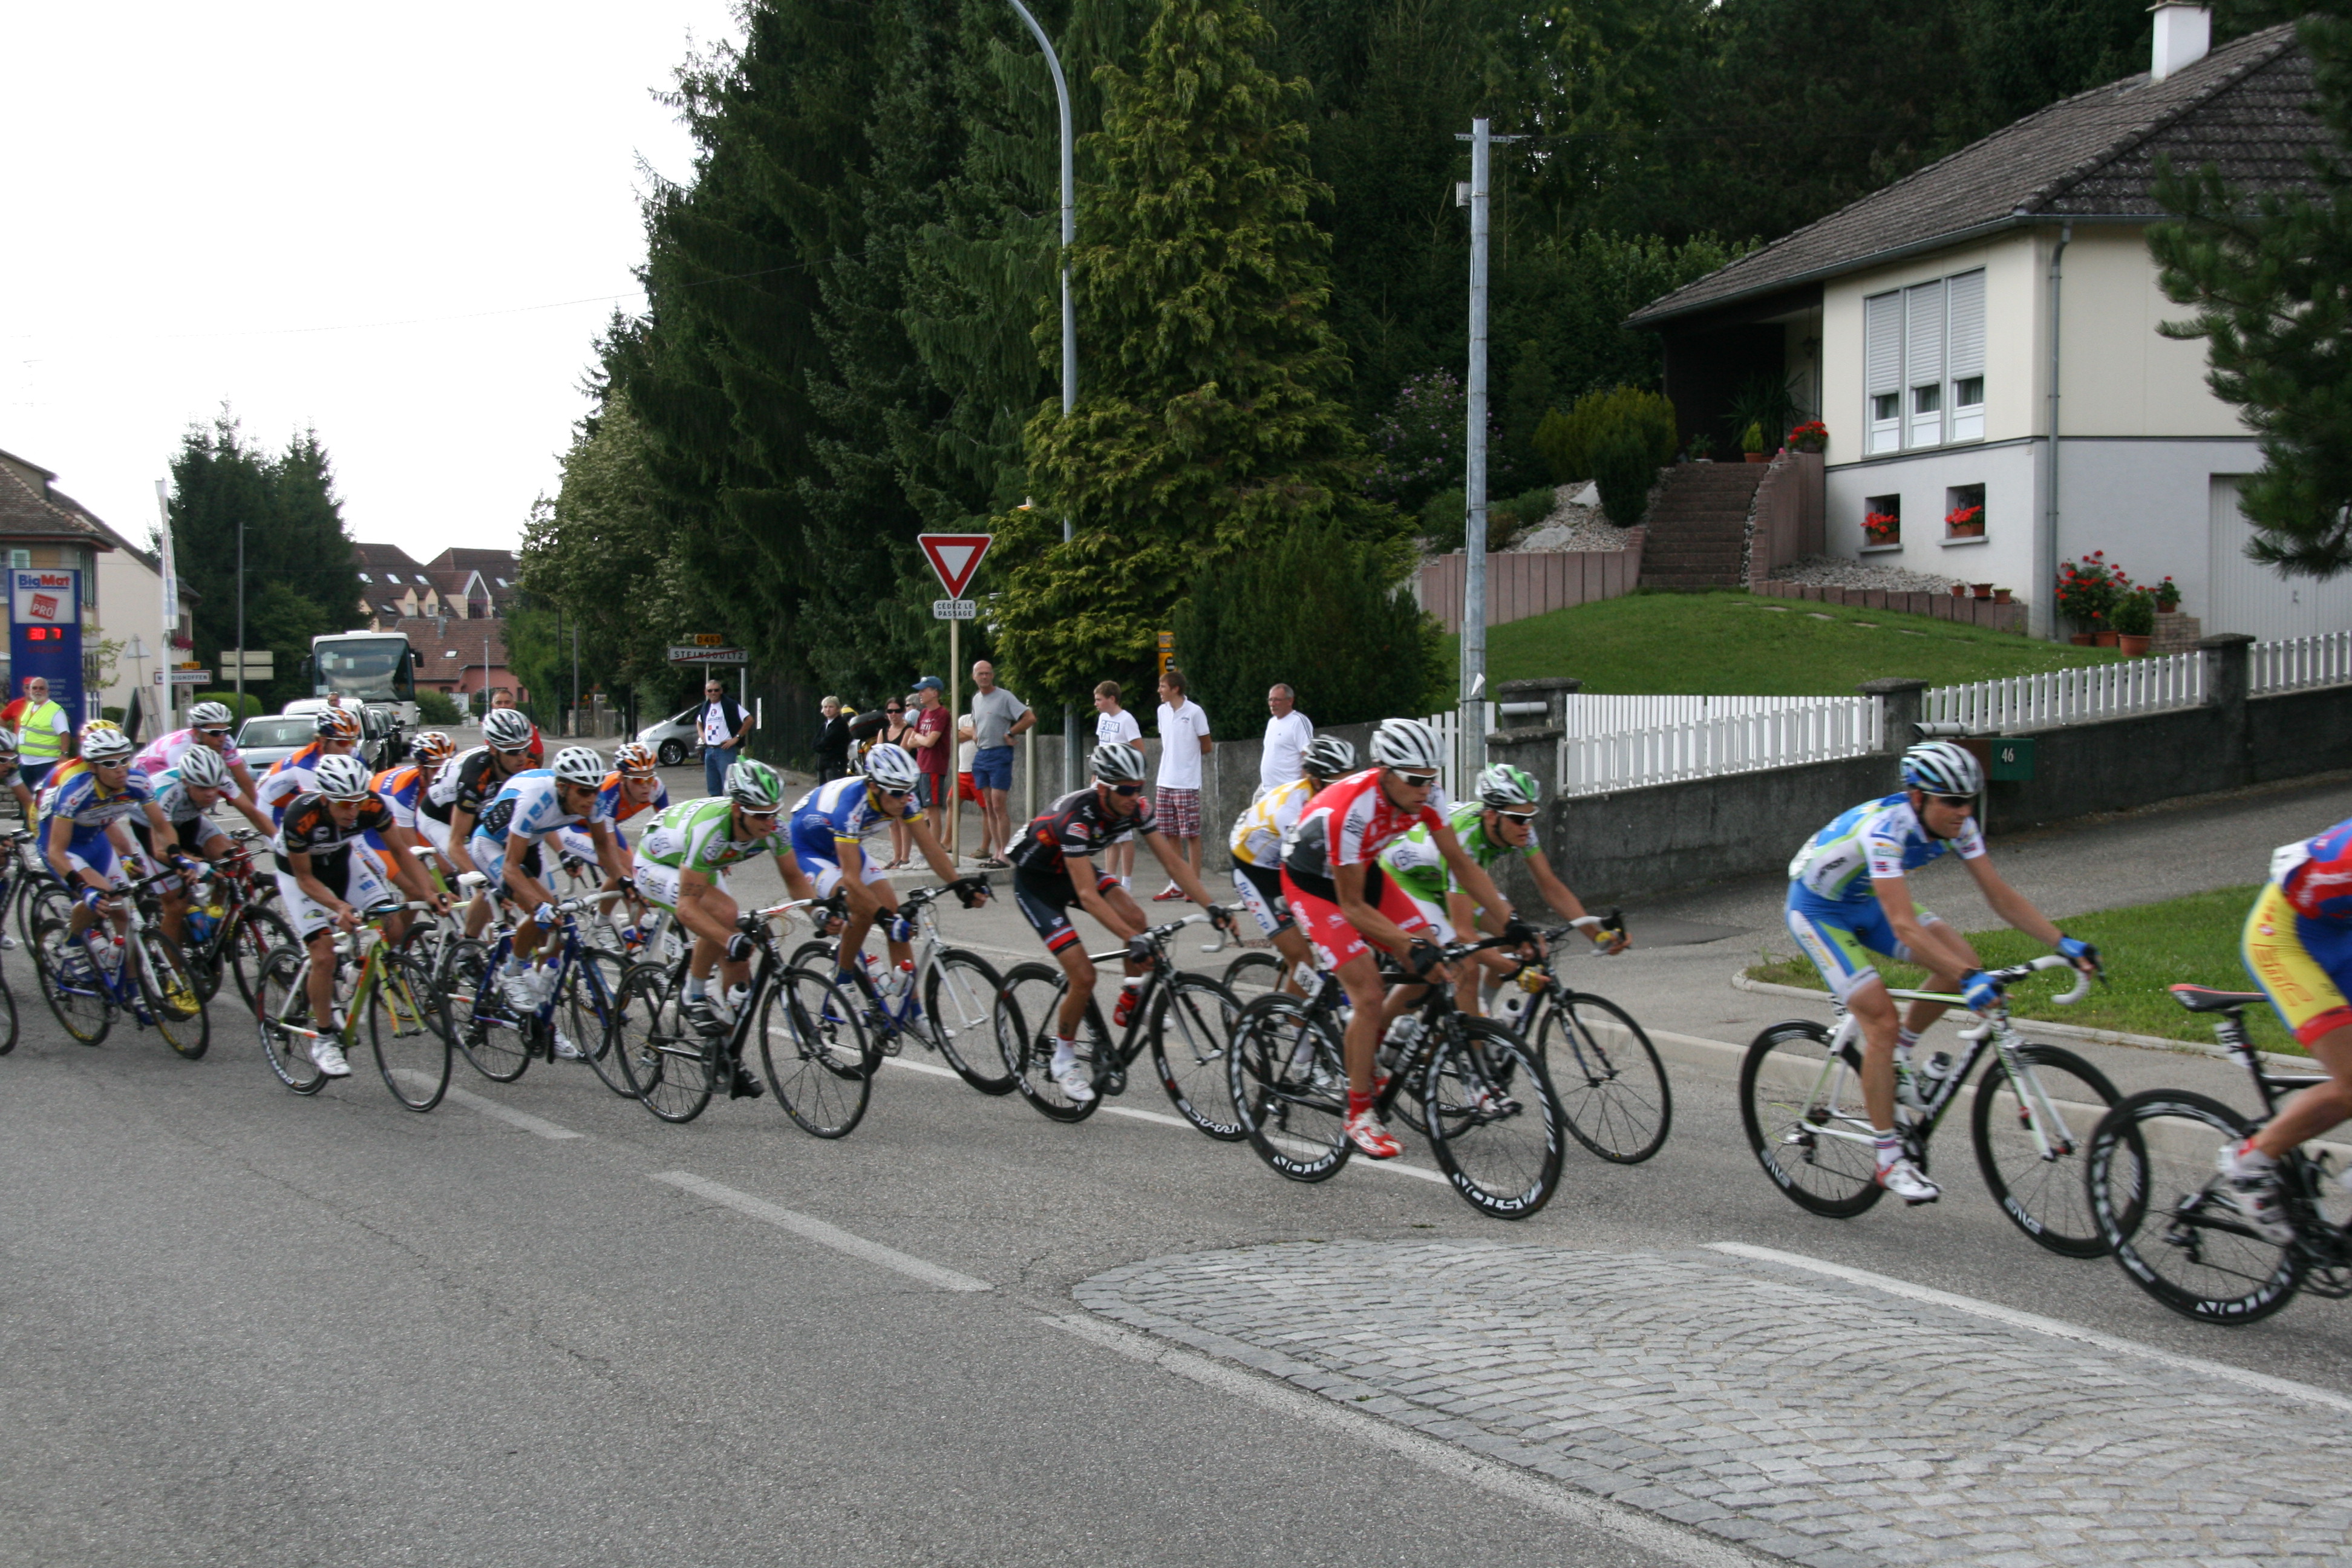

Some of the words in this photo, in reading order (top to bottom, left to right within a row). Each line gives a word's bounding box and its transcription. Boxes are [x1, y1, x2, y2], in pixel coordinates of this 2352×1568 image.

[19, 575, 71, 588] BigMat
[32, 604, 54, 618] PRO
[674, 650, 744, 660] STEINSOULTZ
[1100, 720, 1119, 732] G-STAR
[2001, 748, 2015, 763] 46
[1177, 1098, 1242, 1134] URA-ACE
[2004, 1195, 2042, 1235] ENVE
